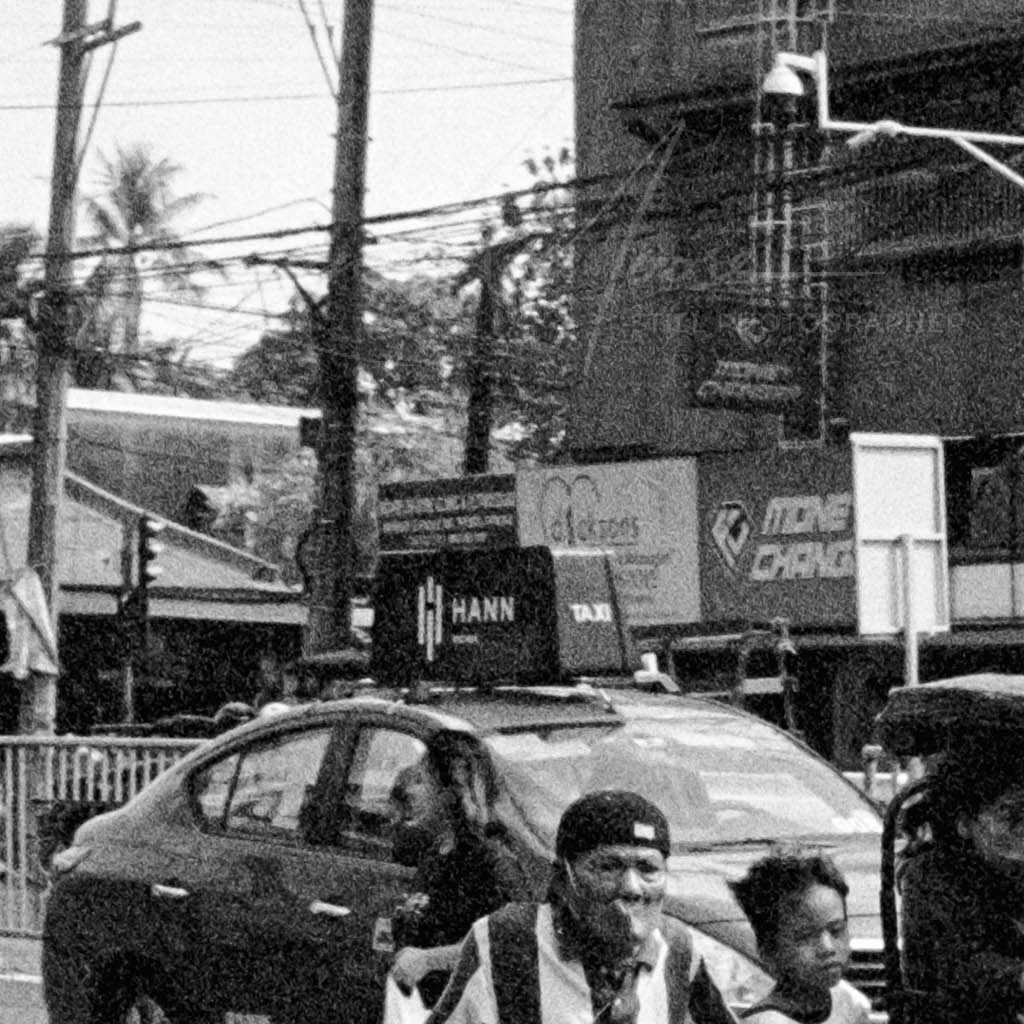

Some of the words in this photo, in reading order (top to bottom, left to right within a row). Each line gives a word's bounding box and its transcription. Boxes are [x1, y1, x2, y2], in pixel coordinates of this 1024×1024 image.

[761, 492, 853, 535] MONE
[750, 540, 855, 581] CHANG
[452, 596, 515, 625] HANN
[569, 602, 612, 624] TAXI
